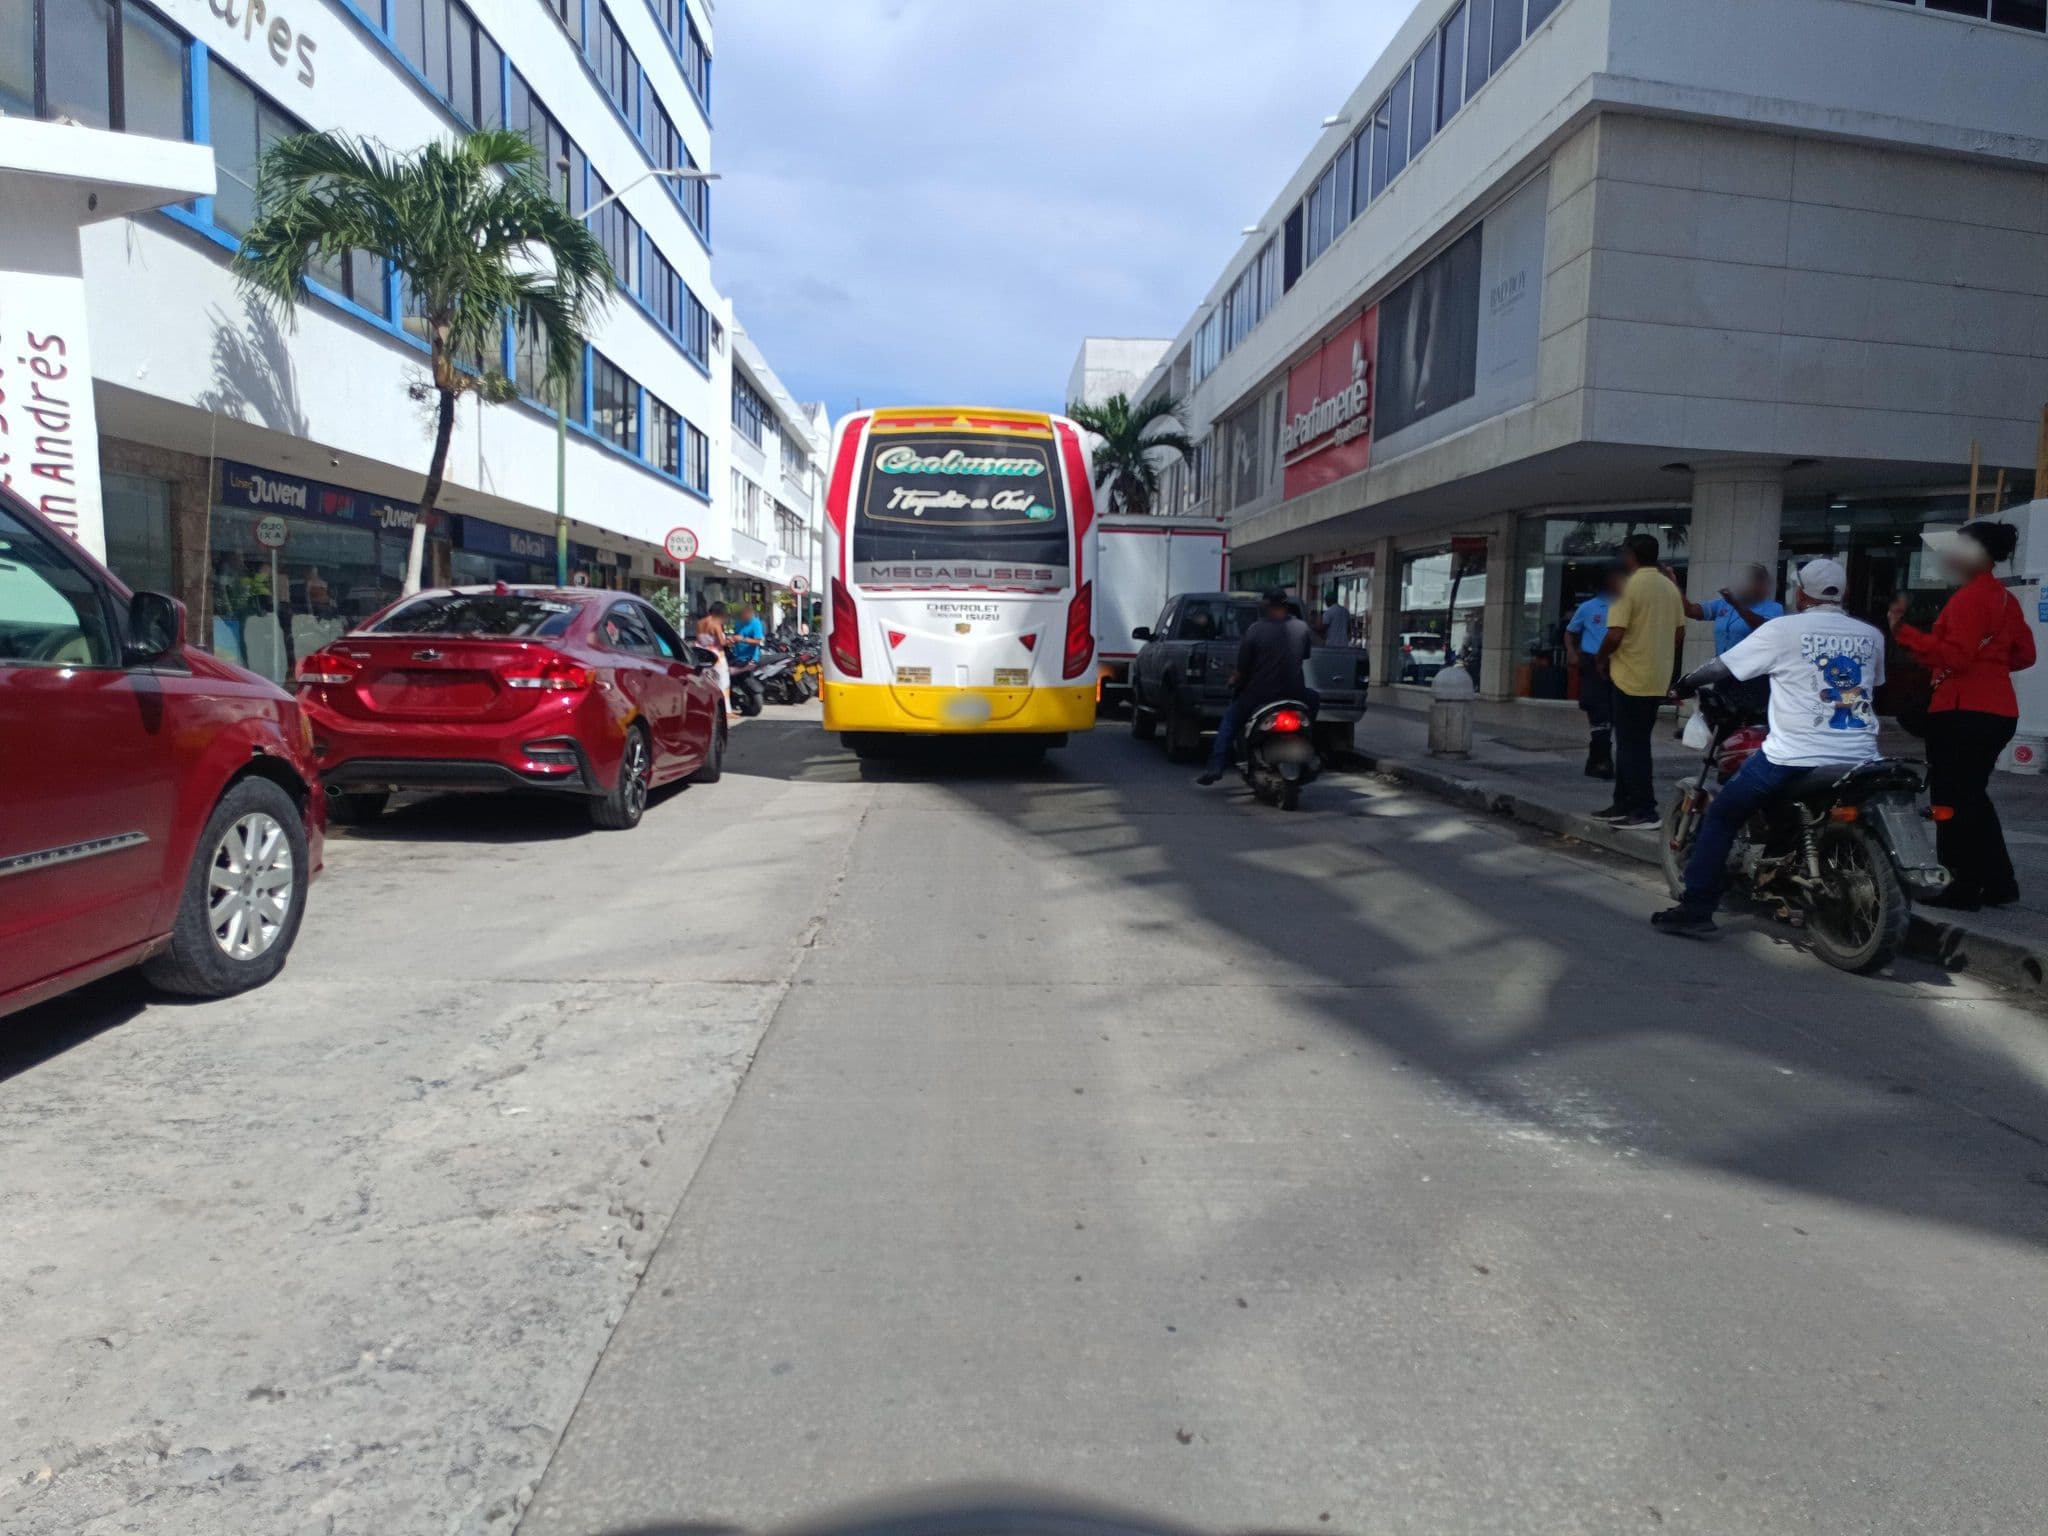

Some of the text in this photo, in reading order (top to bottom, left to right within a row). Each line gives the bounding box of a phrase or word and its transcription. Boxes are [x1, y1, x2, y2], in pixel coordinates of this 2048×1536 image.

[670, 534, 694, 545] SOLO
[870, 567, 1053, 581] MEGABUSES
[927, 604, 1000, 613] CHEVROLET
[966, 613, 1000, 621] ISUZU
